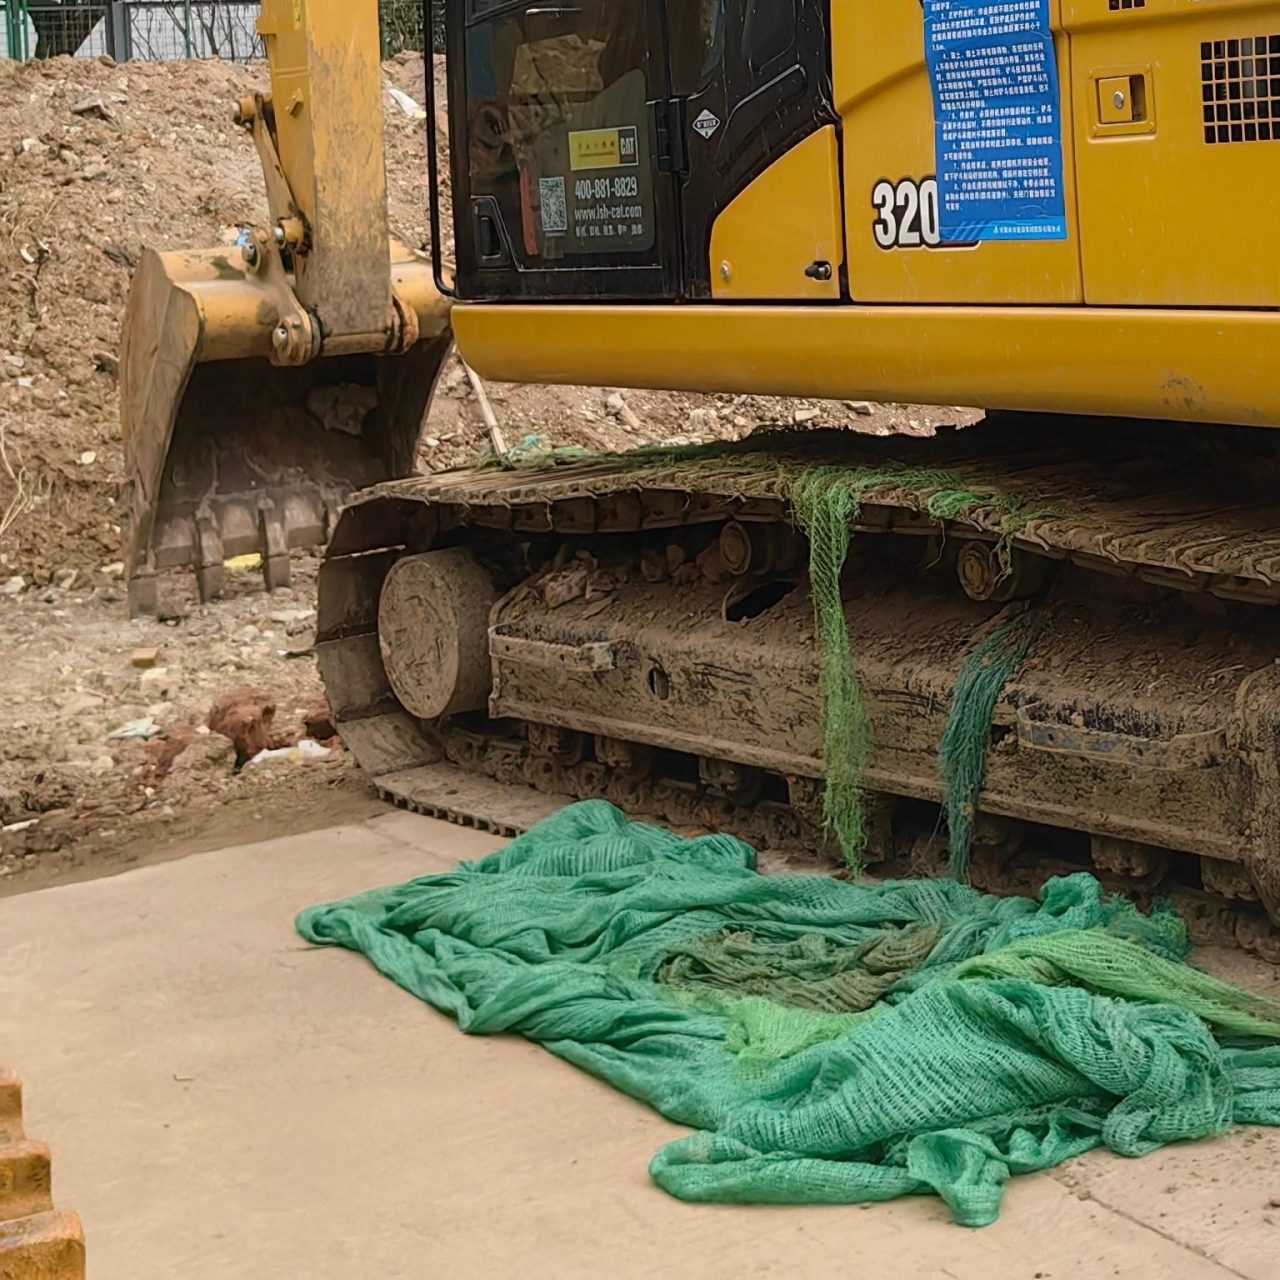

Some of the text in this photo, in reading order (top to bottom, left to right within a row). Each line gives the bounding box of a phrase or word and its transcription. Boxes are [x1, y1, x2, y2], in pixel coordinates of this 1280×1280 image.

[620, 137, 635, 156] CAT
[575, 176, 637, 199] 400-881-8829
[873, 179, 941, 245] 320
